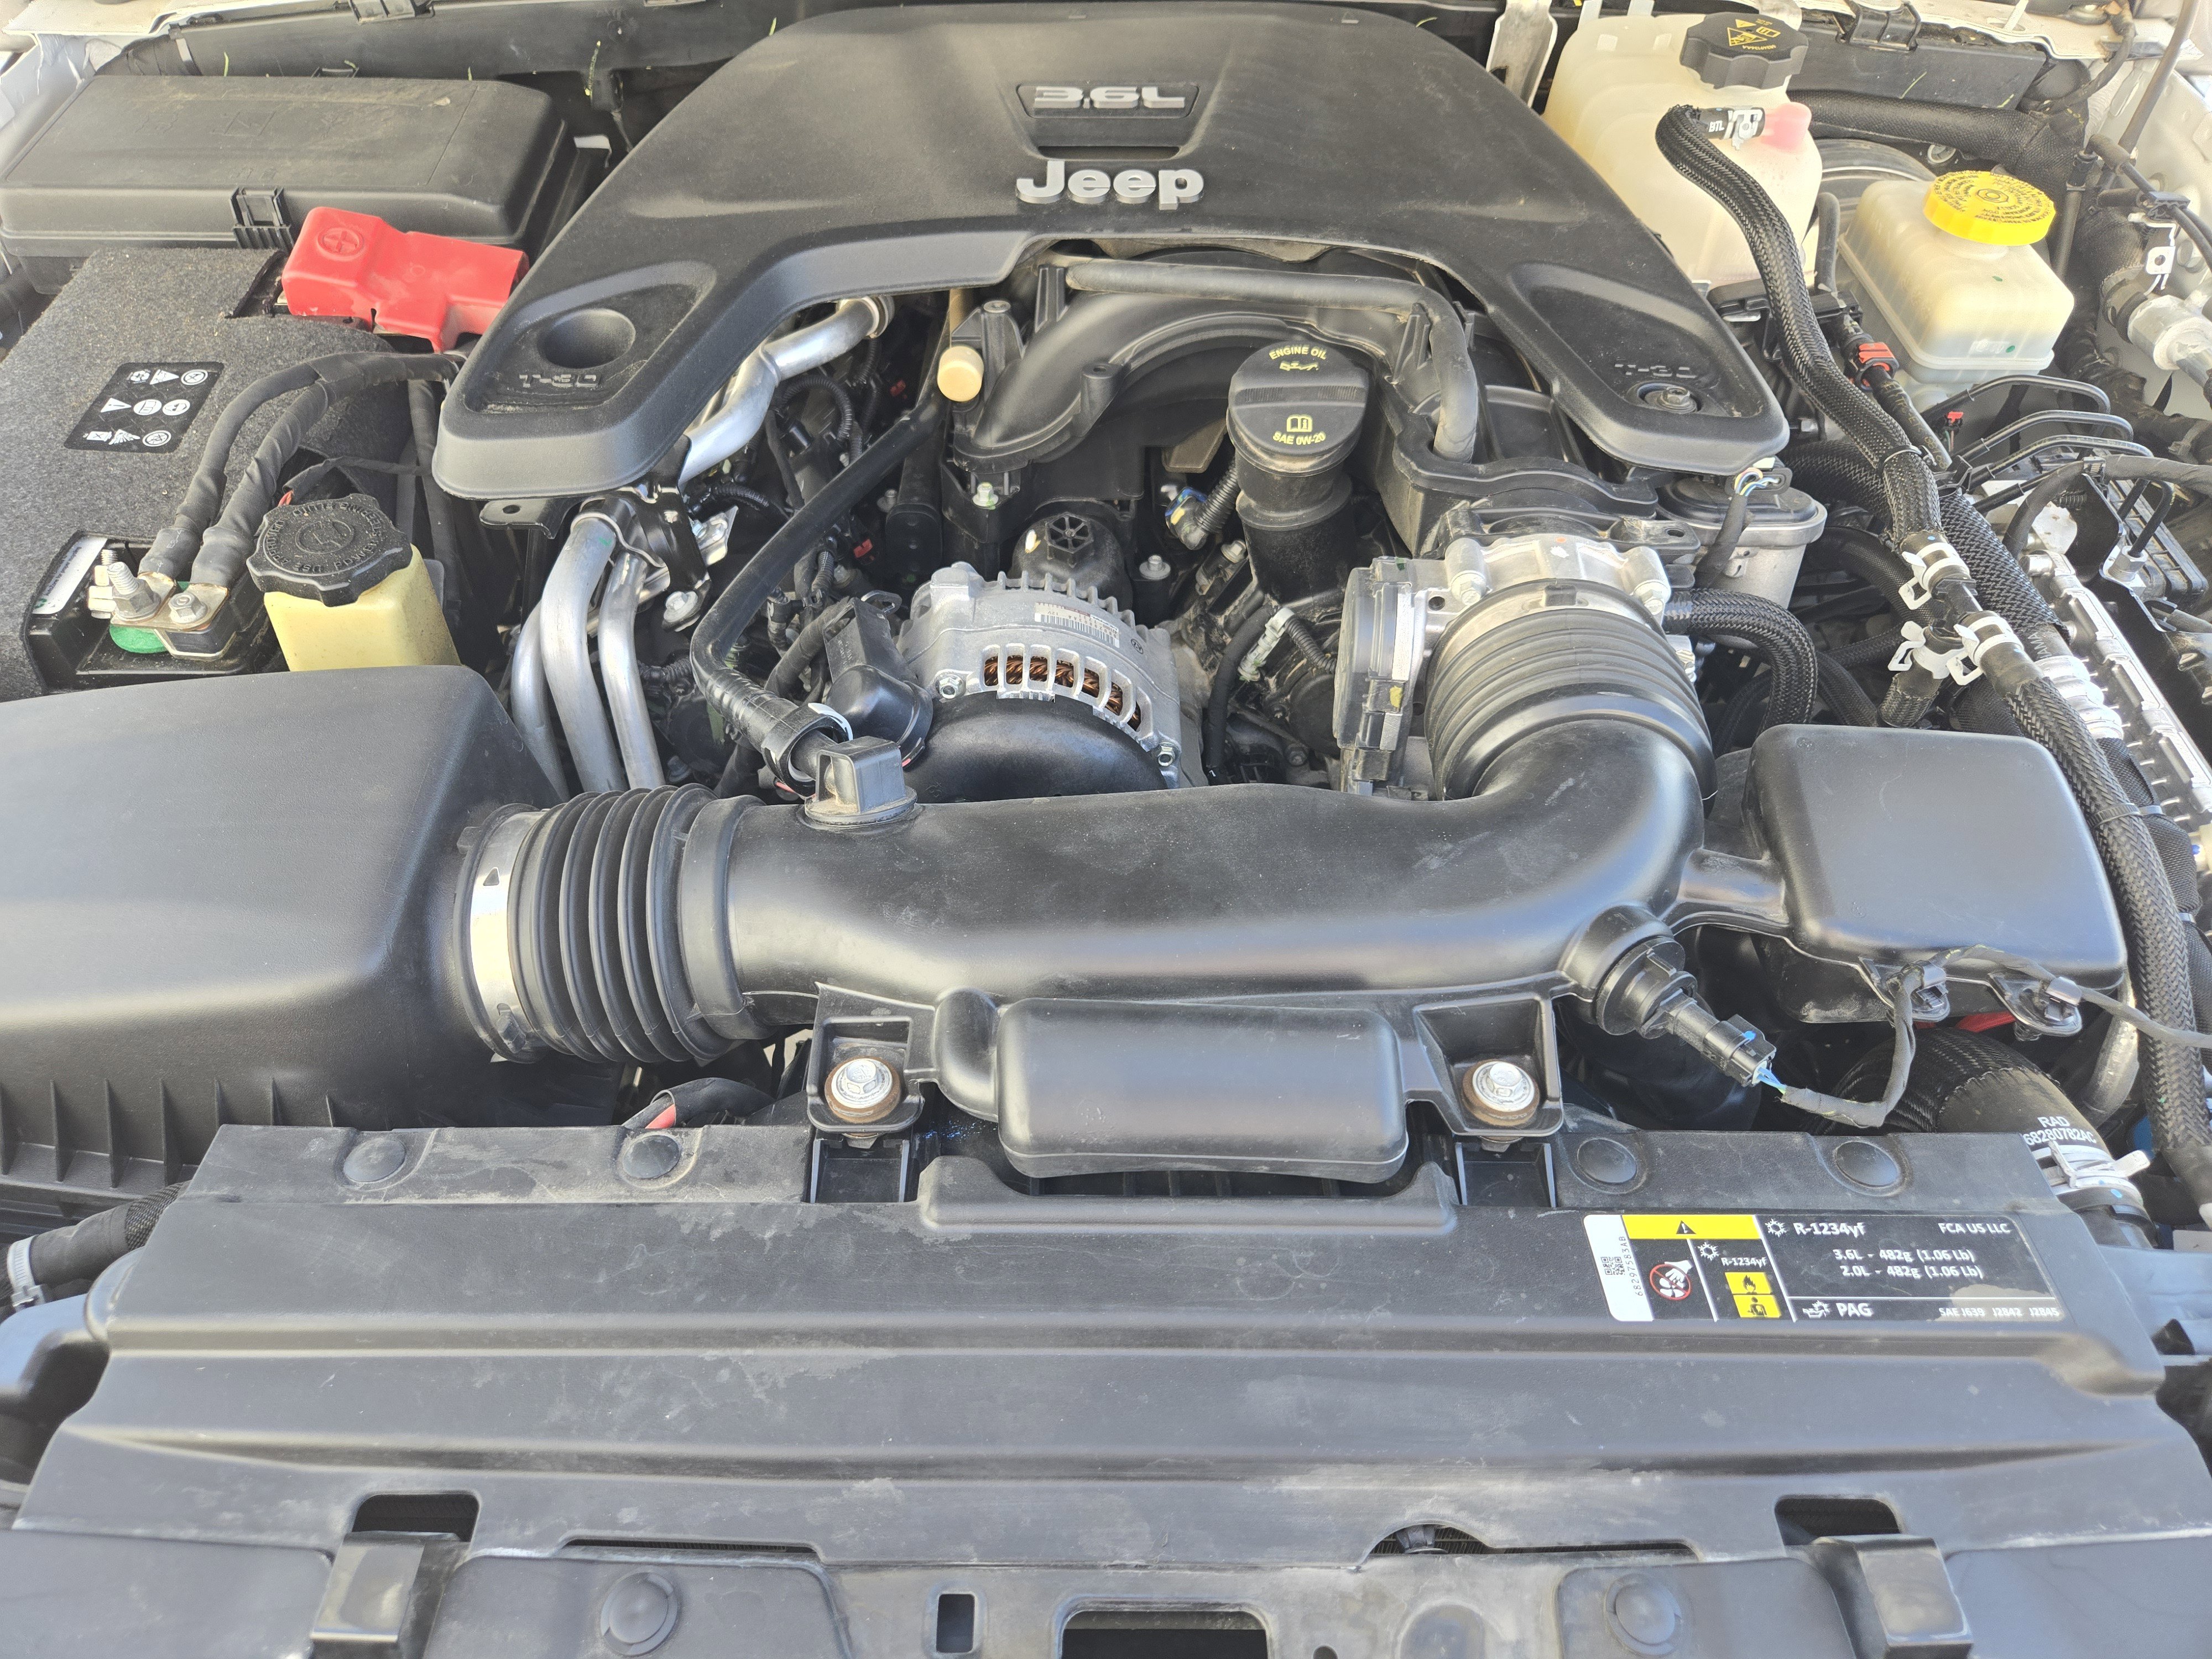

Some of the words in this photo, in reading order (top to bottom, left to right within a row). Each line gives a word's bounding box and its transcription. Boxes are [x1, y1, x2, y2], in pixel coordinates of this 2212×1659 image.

[1034, 87, 1185, 108] 3.6L
[1708, 120, 1725, 132] BTL
[1016, 160, 1204, 210] Jeep
[1269, 345, 1309, 359] ENGINE
[1311, 346, 1327, 359] OIL
[1273, 431, 1295, 445] SAE
[1296, 431, 1326, 445] 0W-20
[2037, 1116, 2070, 1128] RAD
[2022, 1128, 2096, 1145] 68280782AC
[1793, 1222, 1866, 1238] R-1234yf
[1938, 1223, 1965, 1234] FCA
[1966, 1223, 1986, 1234] US
[1986, 1223, 2011, 1234] LLC
[1721, 1257, 1768, 1267] R-1234yf
[1833, 1249, 1864, 1260] 3.6L
[1879, 1249, 1913, 1262] 482g
[1917, 1249, 1952, 1263] (1.06
[1952, 1249, 1976, 1263] Lb)
[1619, 1236, 1643, 1296] 68297583AB
[1840, 1266, 1871, 1277] 2.0L
[1887, 1266, 1921, 1280] 482g
[1924, 1265, 1959, 1279] (1.06
[1960, 1265, 1984, 1280] Lb)
[1836, 1302, 1874, 1317] PAG
[1939, 1307, 1960, 1317] SAE
[1961, 1307, 1986, 1317] J639
[1991, 1307, 2023, 1317] J2842
[2028, 1307, 2060, 1317] J2845
